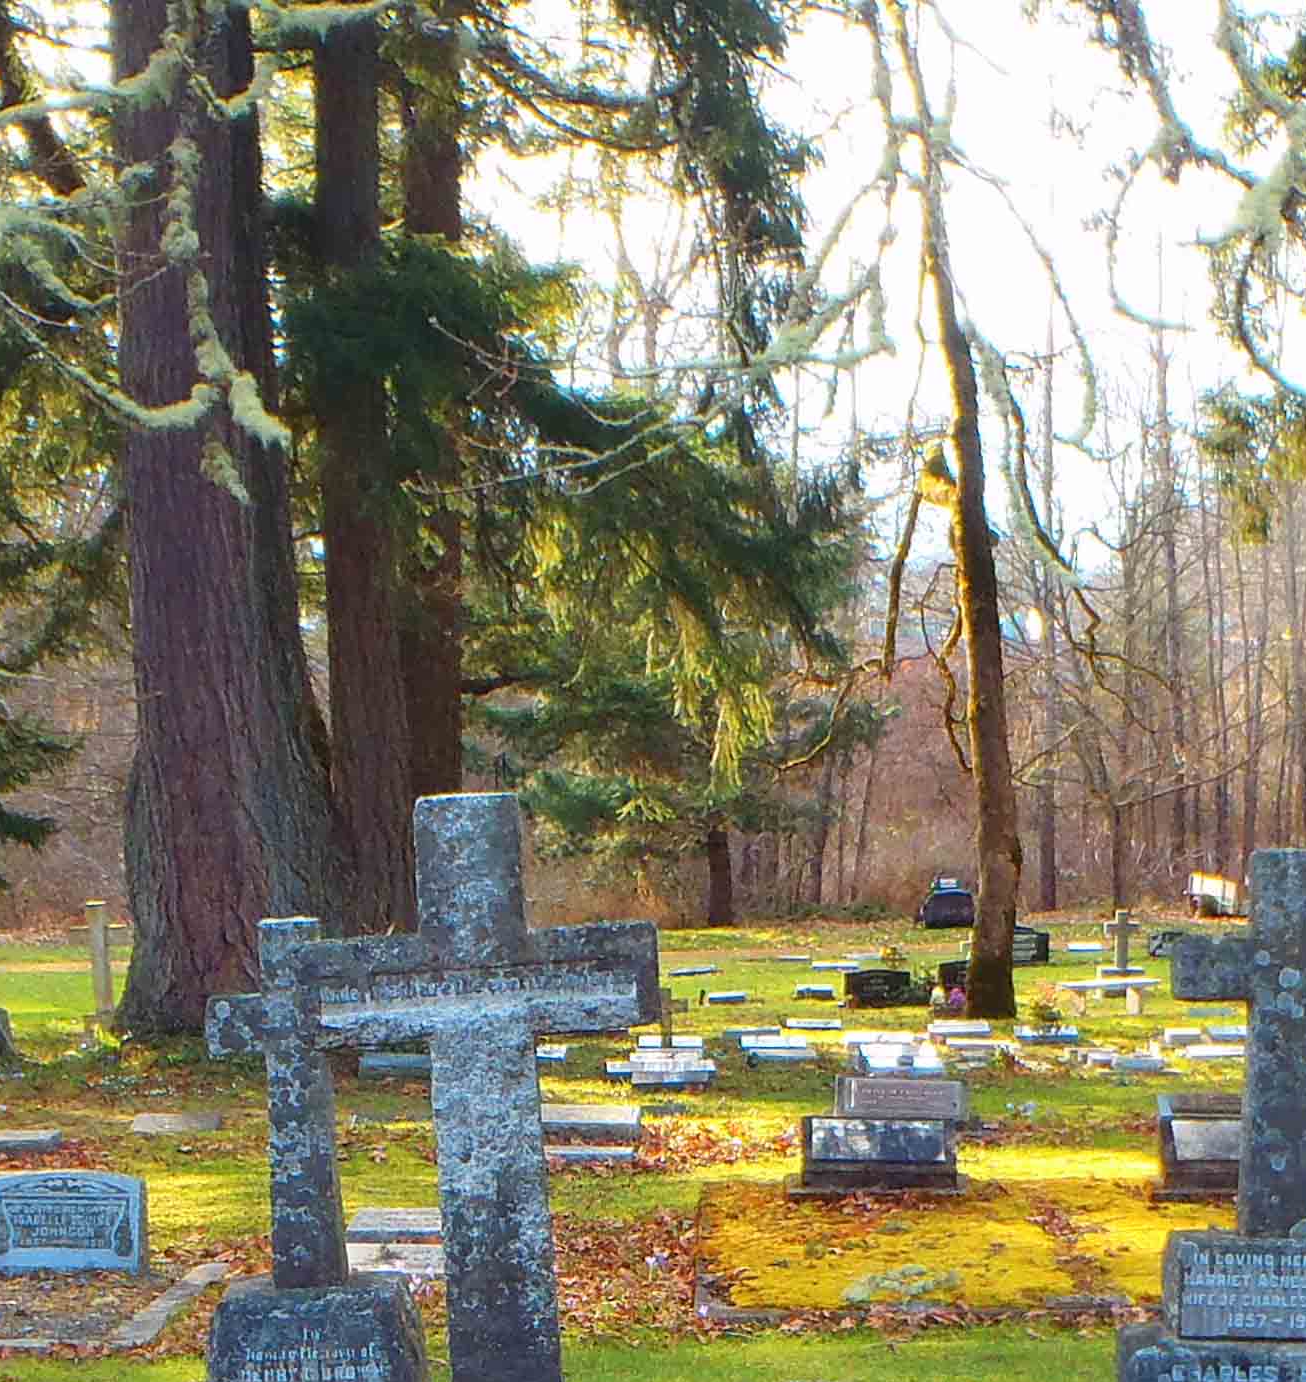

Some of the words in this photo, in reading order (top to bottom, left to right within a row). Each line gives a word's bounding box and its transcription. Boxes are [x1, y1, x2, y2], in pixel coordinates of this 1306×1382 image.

[1194, 1253, 1209, 1266] IN
[1215, 1253, 1275, 1266] LOVING
[1227, 1313, 1268, 1330] 1857
